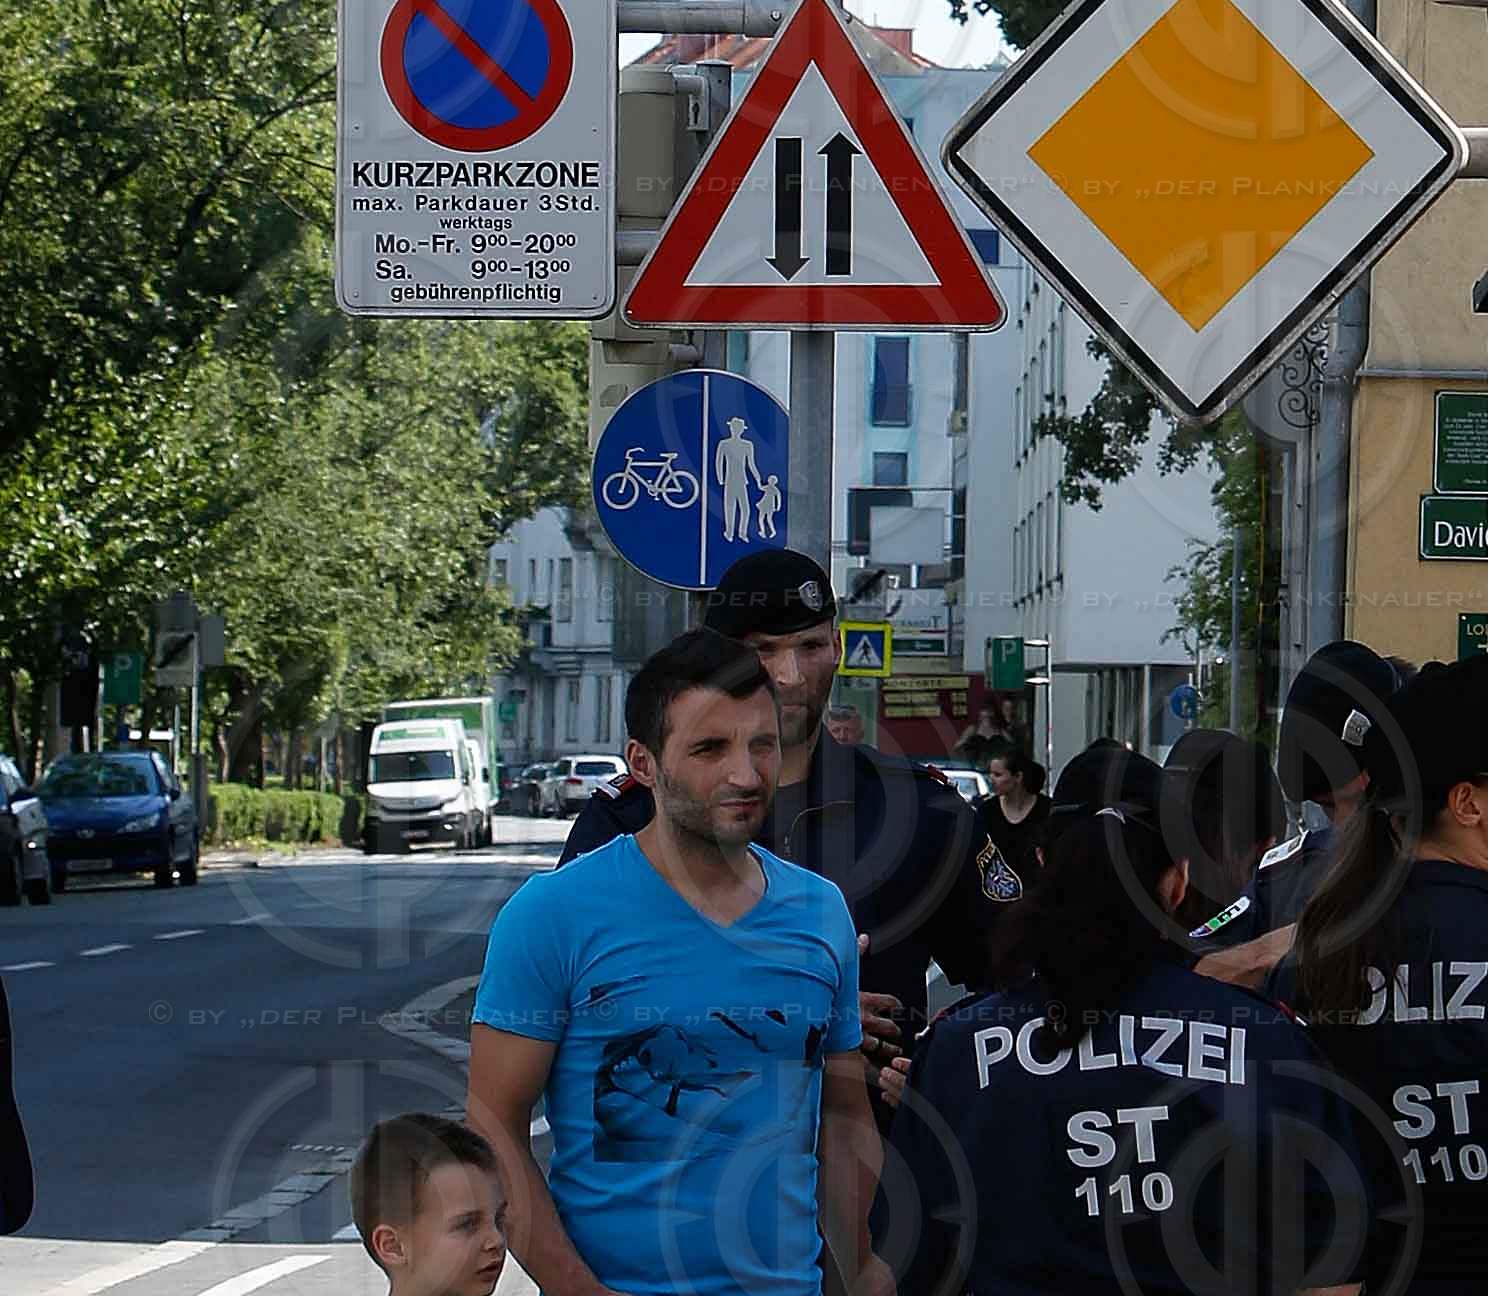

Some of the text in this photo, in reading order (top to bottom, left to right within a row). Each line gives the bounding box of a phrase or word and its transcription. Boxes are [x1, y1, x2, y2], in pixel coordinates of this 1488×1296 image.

[352, 161, 600, 188] KURZPARKZONE
[352, 198, 403, 212] max.
[415, 194, 529, 212] Parkdauer
[439, 216, 514, 232] werktags
[375, 234, 461, 254] Mo.-Fr.
[375, 260, 413, 280] Sa.
[390, 283, 562, 304] gebührenpflichtig
[1466, 623, 1488, 636] LO
[973, 1014, 1247, 1090] POLIZEI
[1392, 1078, 1481, 1141] ST
[1065, 1104, 1170, 1169] ST
[1073, 1170, 1175, 1217] 110
